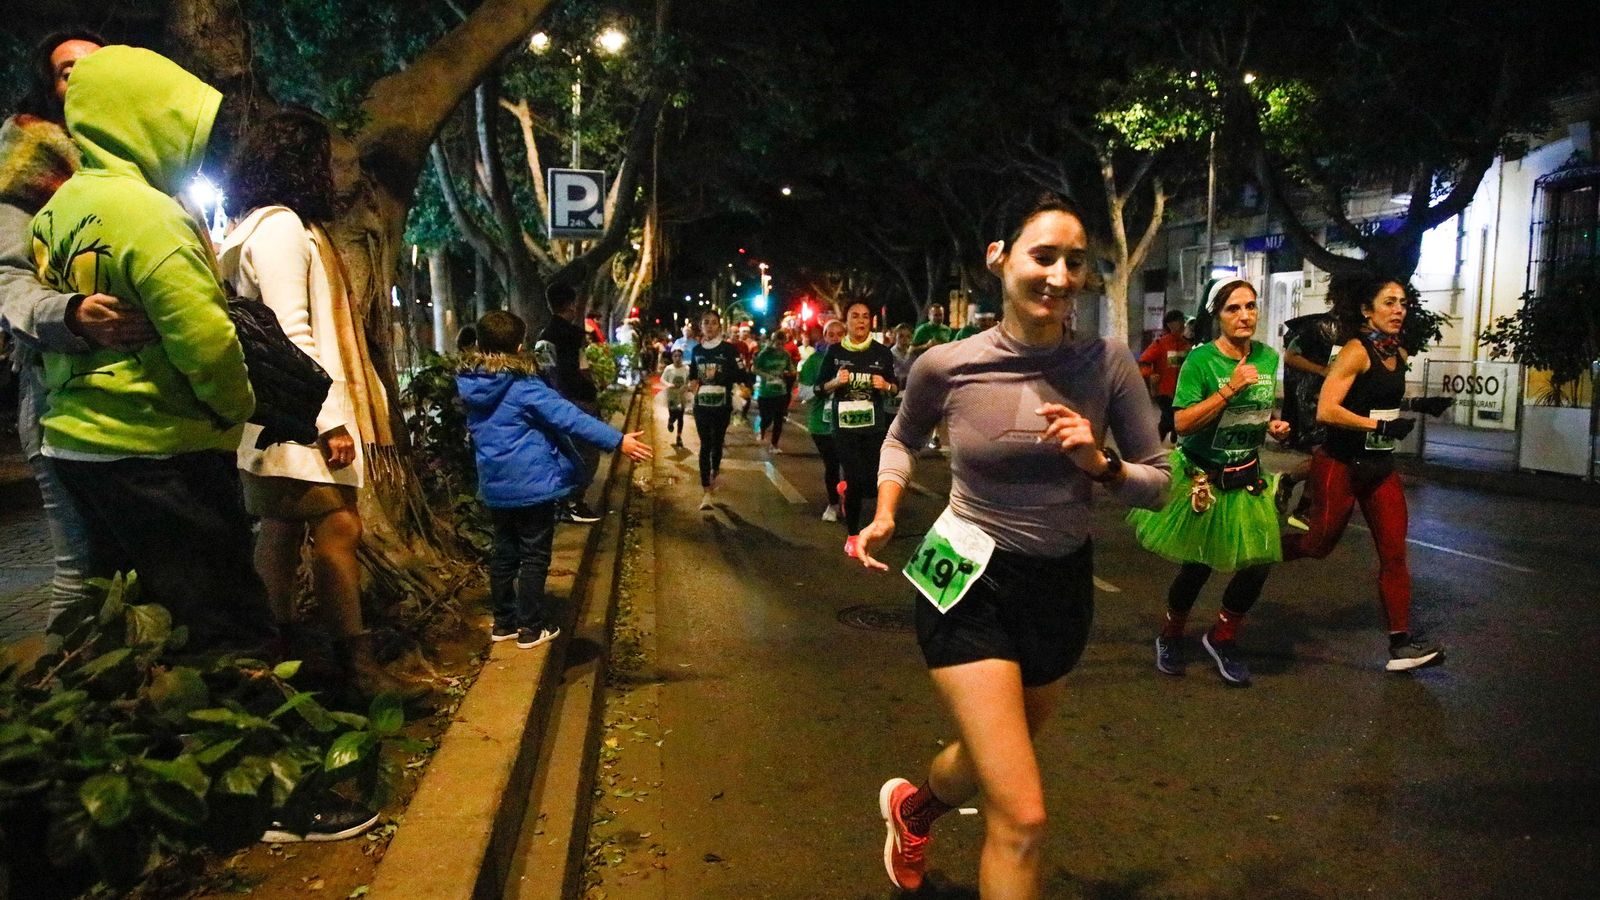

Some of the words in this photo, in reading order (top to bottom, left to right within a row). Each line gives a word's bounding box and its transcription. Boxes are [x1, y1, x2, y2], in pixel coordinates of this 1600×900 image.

[555, 173, 599, 226] P
[570, 219, 586, 228] 24h
[1442, 374, 1499, 395] ROSSO
[1459, 399, 1497, 409] RESTAURANT
[842, 413, 872, 424] 1275
[911, 547, 974, 589] 19
